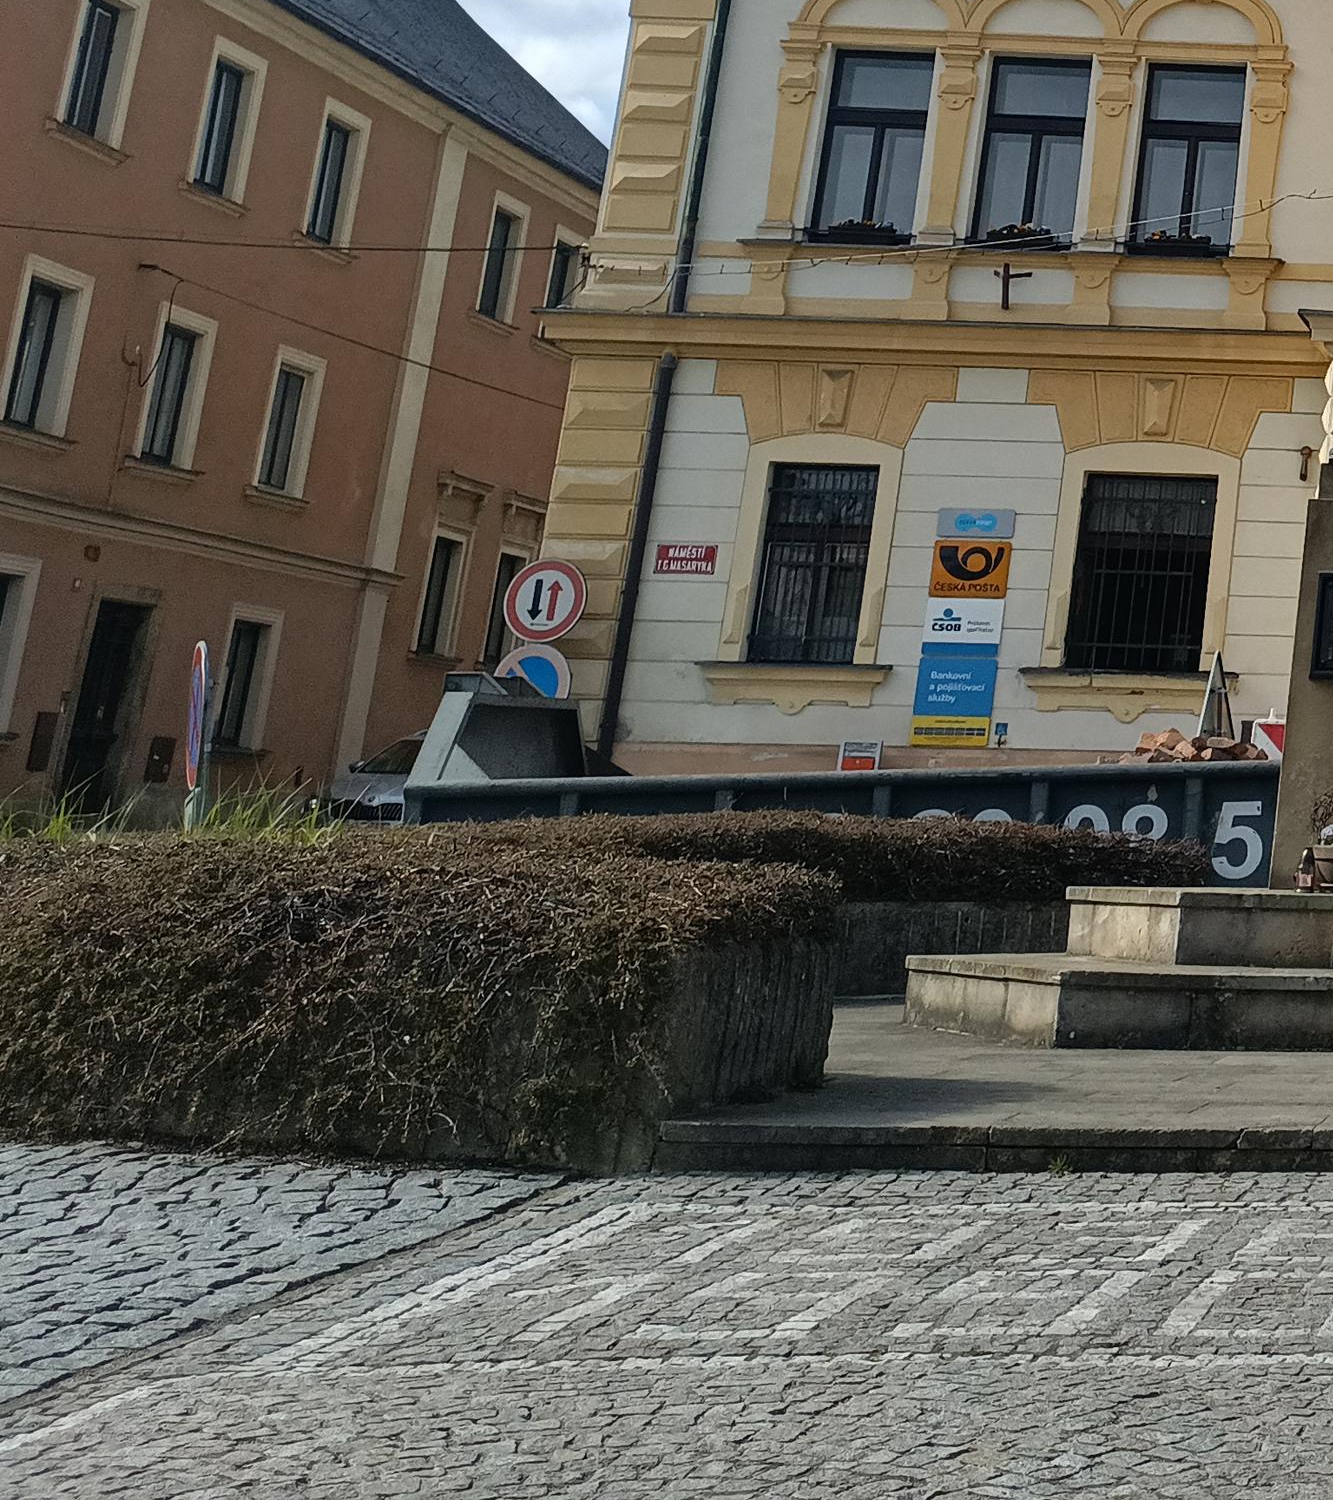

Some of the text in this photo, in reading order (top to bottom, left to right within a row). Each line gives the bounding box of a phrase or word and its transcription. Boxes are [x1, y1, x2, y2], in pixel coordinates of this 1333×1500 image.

[668, 545, 706, 559] NÁMĚSTÍ
[933, 581, 1000, 592] ČESKÁ POŠTA
[931, 671, 971, 680] Bankovní
